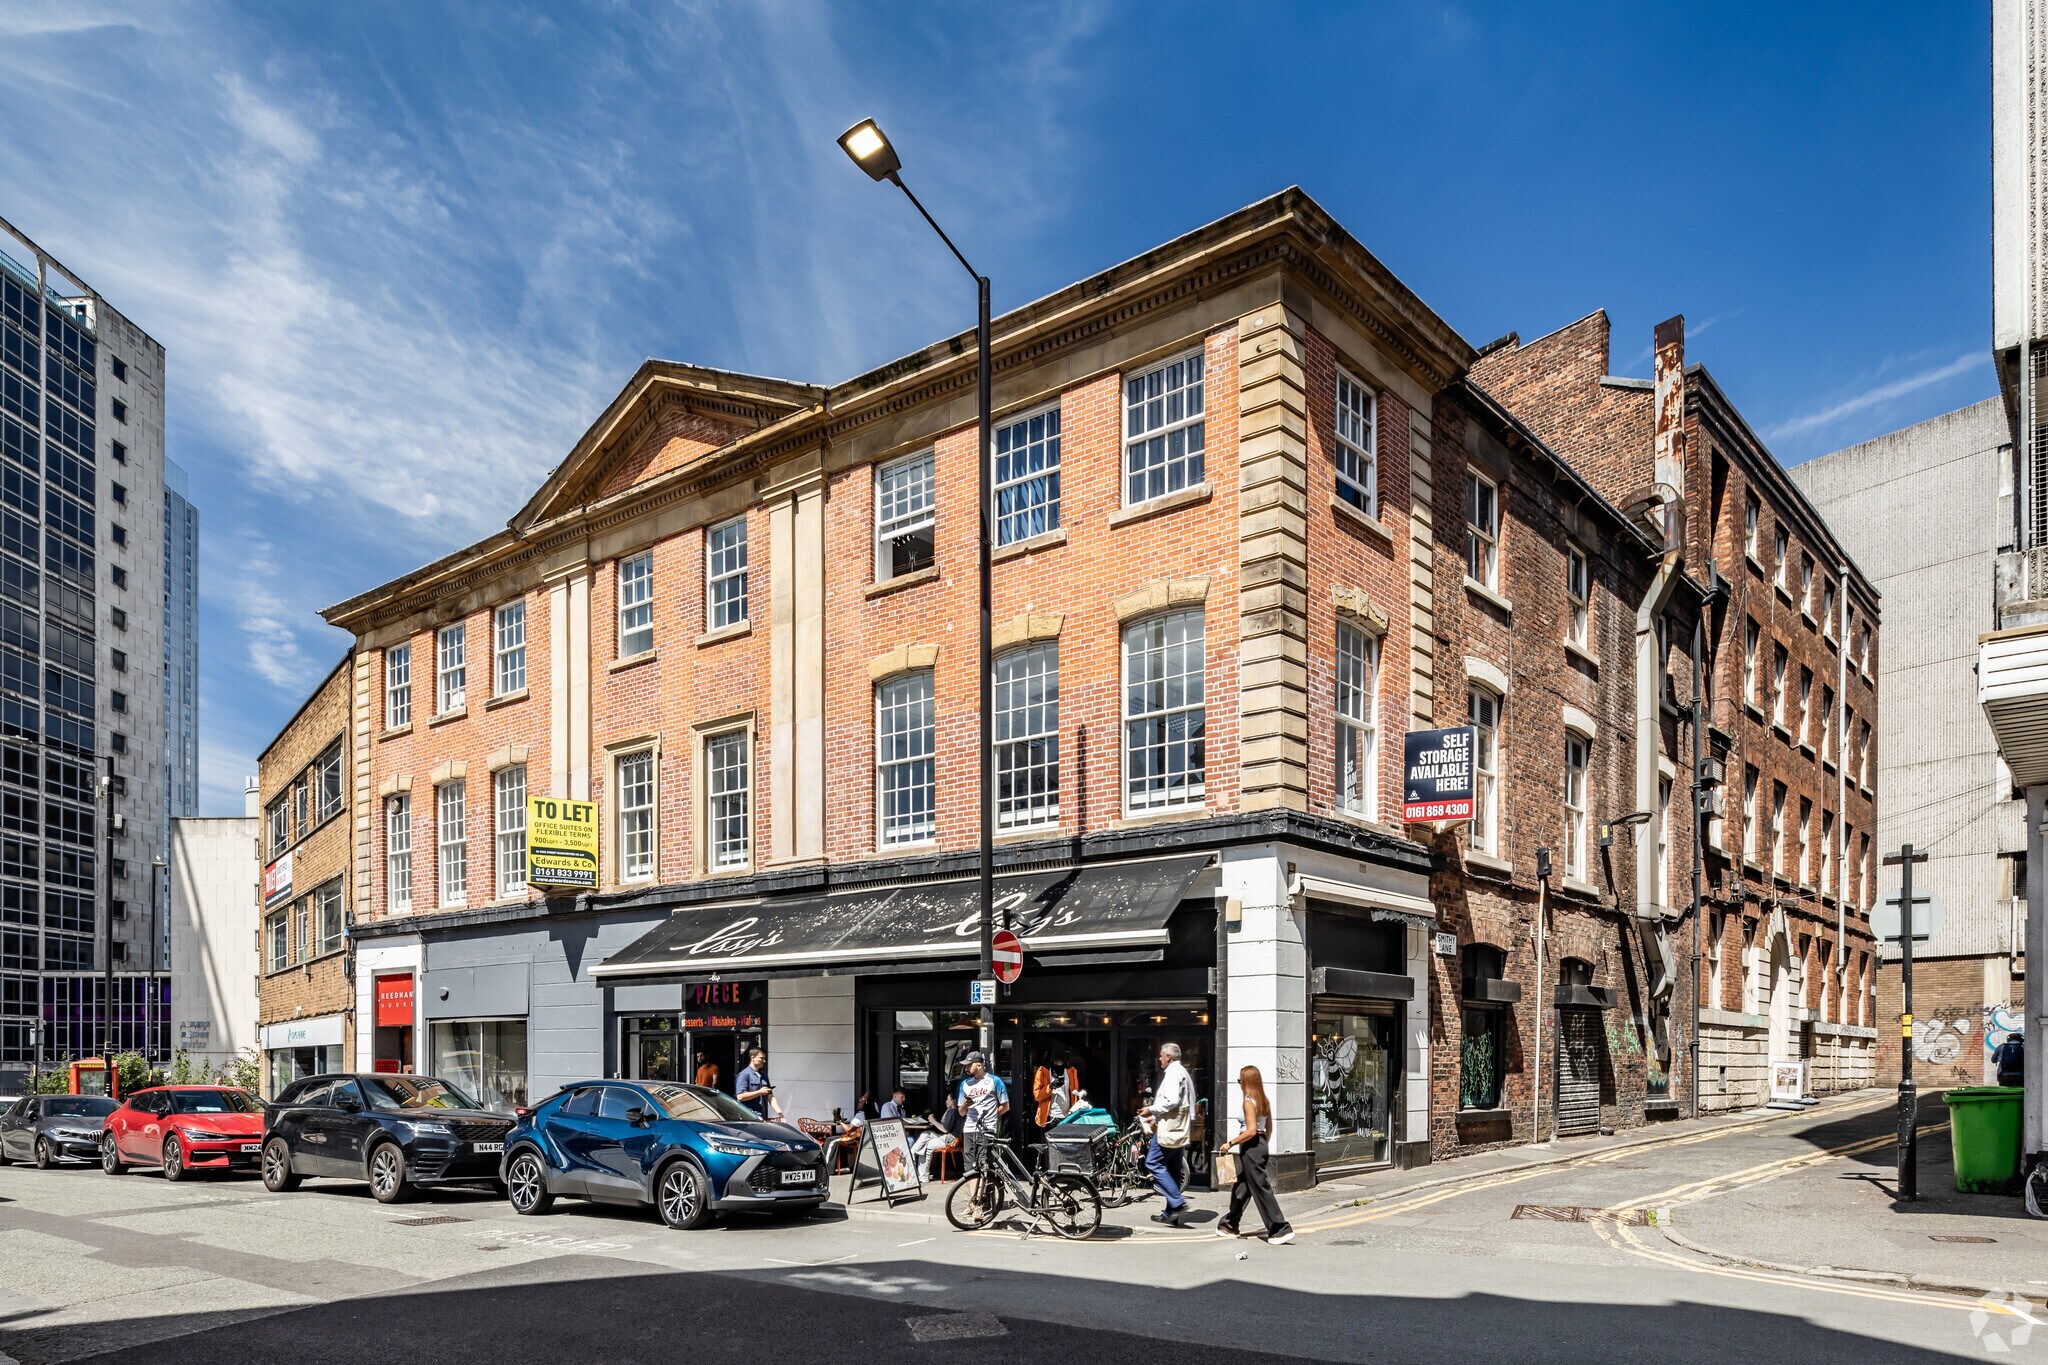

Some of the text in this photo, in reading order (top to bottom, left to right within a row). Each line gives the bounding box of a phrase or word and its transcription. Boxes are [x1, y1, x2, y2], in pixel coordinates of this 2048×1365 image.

[1443, 733, 1470, 749] SELF
[1419, 747, 1469, 765] STORAGE
[1410, 762, 1469, 780] AVAILABLE
[1436, 776, 1469, 792] HERE!
[534, 800, 593, 823] TO LET
[1406, 803, 1469, 818] 0161 868 4300
[534, 822, 558, 830] OFFICE
[560, 824, 583, 832] SUITES
[536, 829, 592, 839] FLEXIBLE TERMS
[535, 857, 592, 868] Edwards & Co
[535, 867, 593, 879] 0161 833 9991
[1437, 934, 1456, 944] SMITHY
[479, 1143, 493, 1152] N44
